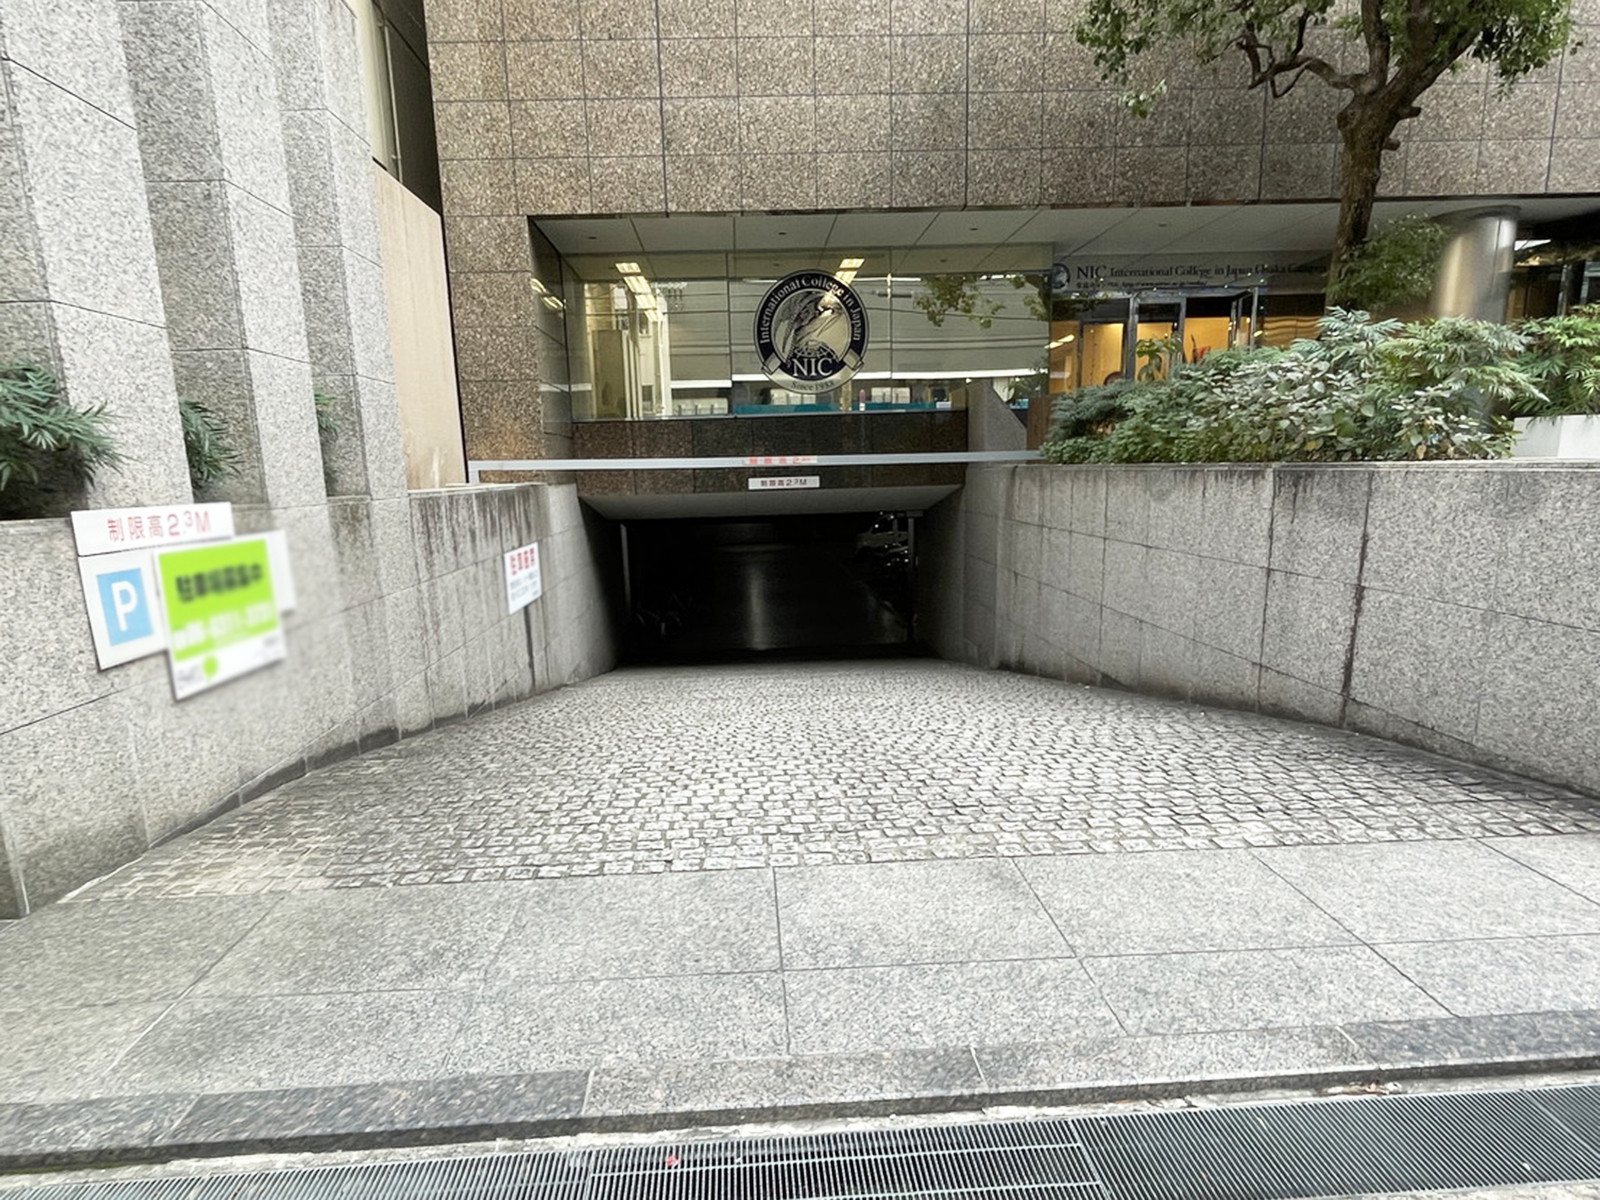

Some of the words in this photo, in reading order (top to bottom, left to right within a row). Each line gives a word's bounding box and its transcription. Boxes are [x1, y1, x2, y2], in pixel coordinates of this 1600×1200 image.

[1077, 265, 1107, 279] NIC
[1110, 267, 1173, 278] International
[1175, 265, 1211, 279] College
[1214, 264, 1225, 275] in
[1226, 264, 1253, 280] Japan
[760, 279, 801, 344] International
[801, 276, 845, 297] College
[842, 292, 856, 308] in
[849, 307, 863, 341] Japan
[793, 358, 834, 377] NIC
[111, 580, 139, 632] P
